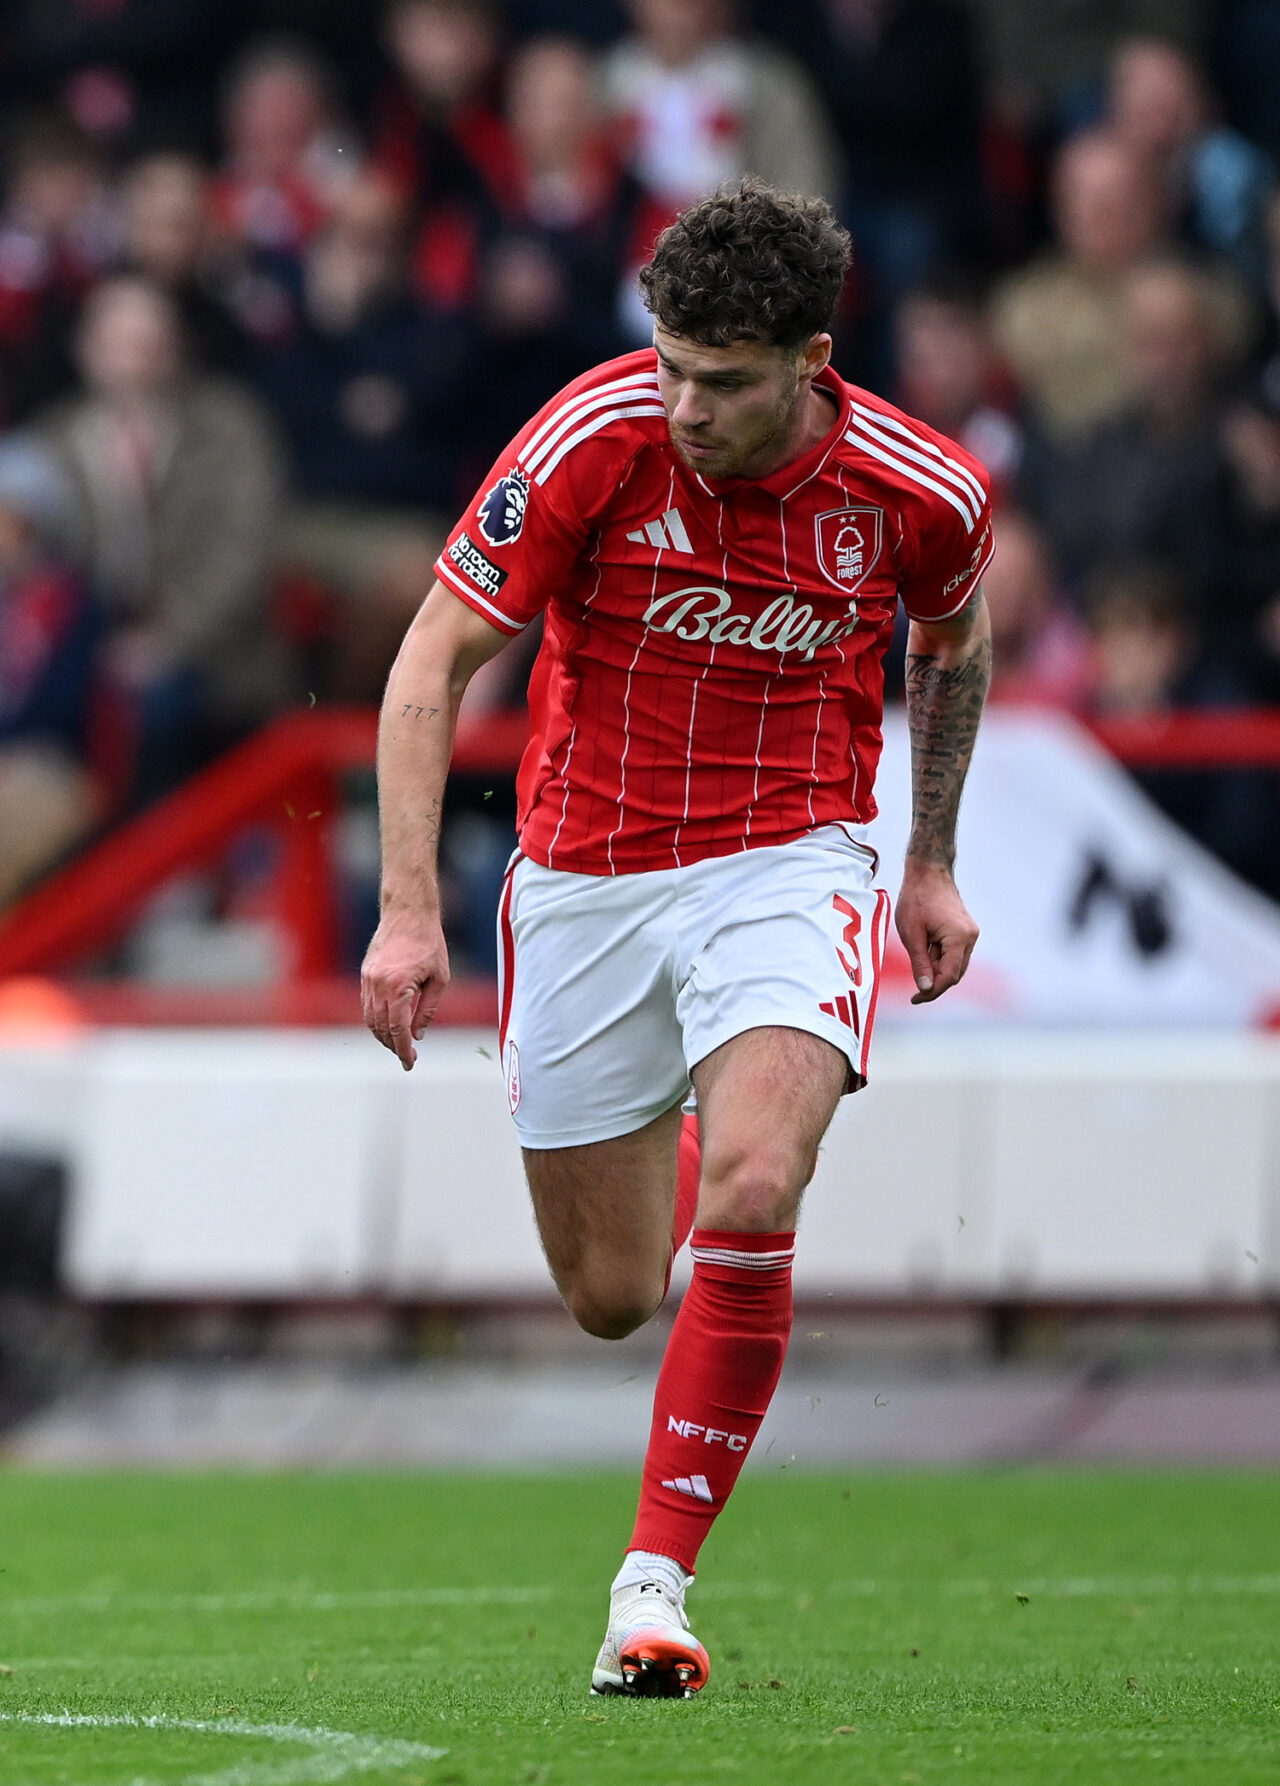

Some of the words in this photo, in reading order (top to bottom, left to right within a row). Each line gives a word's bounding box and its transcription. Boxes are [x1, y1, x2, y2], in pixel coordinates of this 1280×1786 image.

[455, 532, 470, 553] No
[465, 548, 500, 582] room
[458, 557, 500, 597] racism
[642, 586, 860, 662] Bally's
[401, 704, 438, 720] 777
[832, 892, 863, 988] 3
[667, 1414, 747, 1452] NFFC
